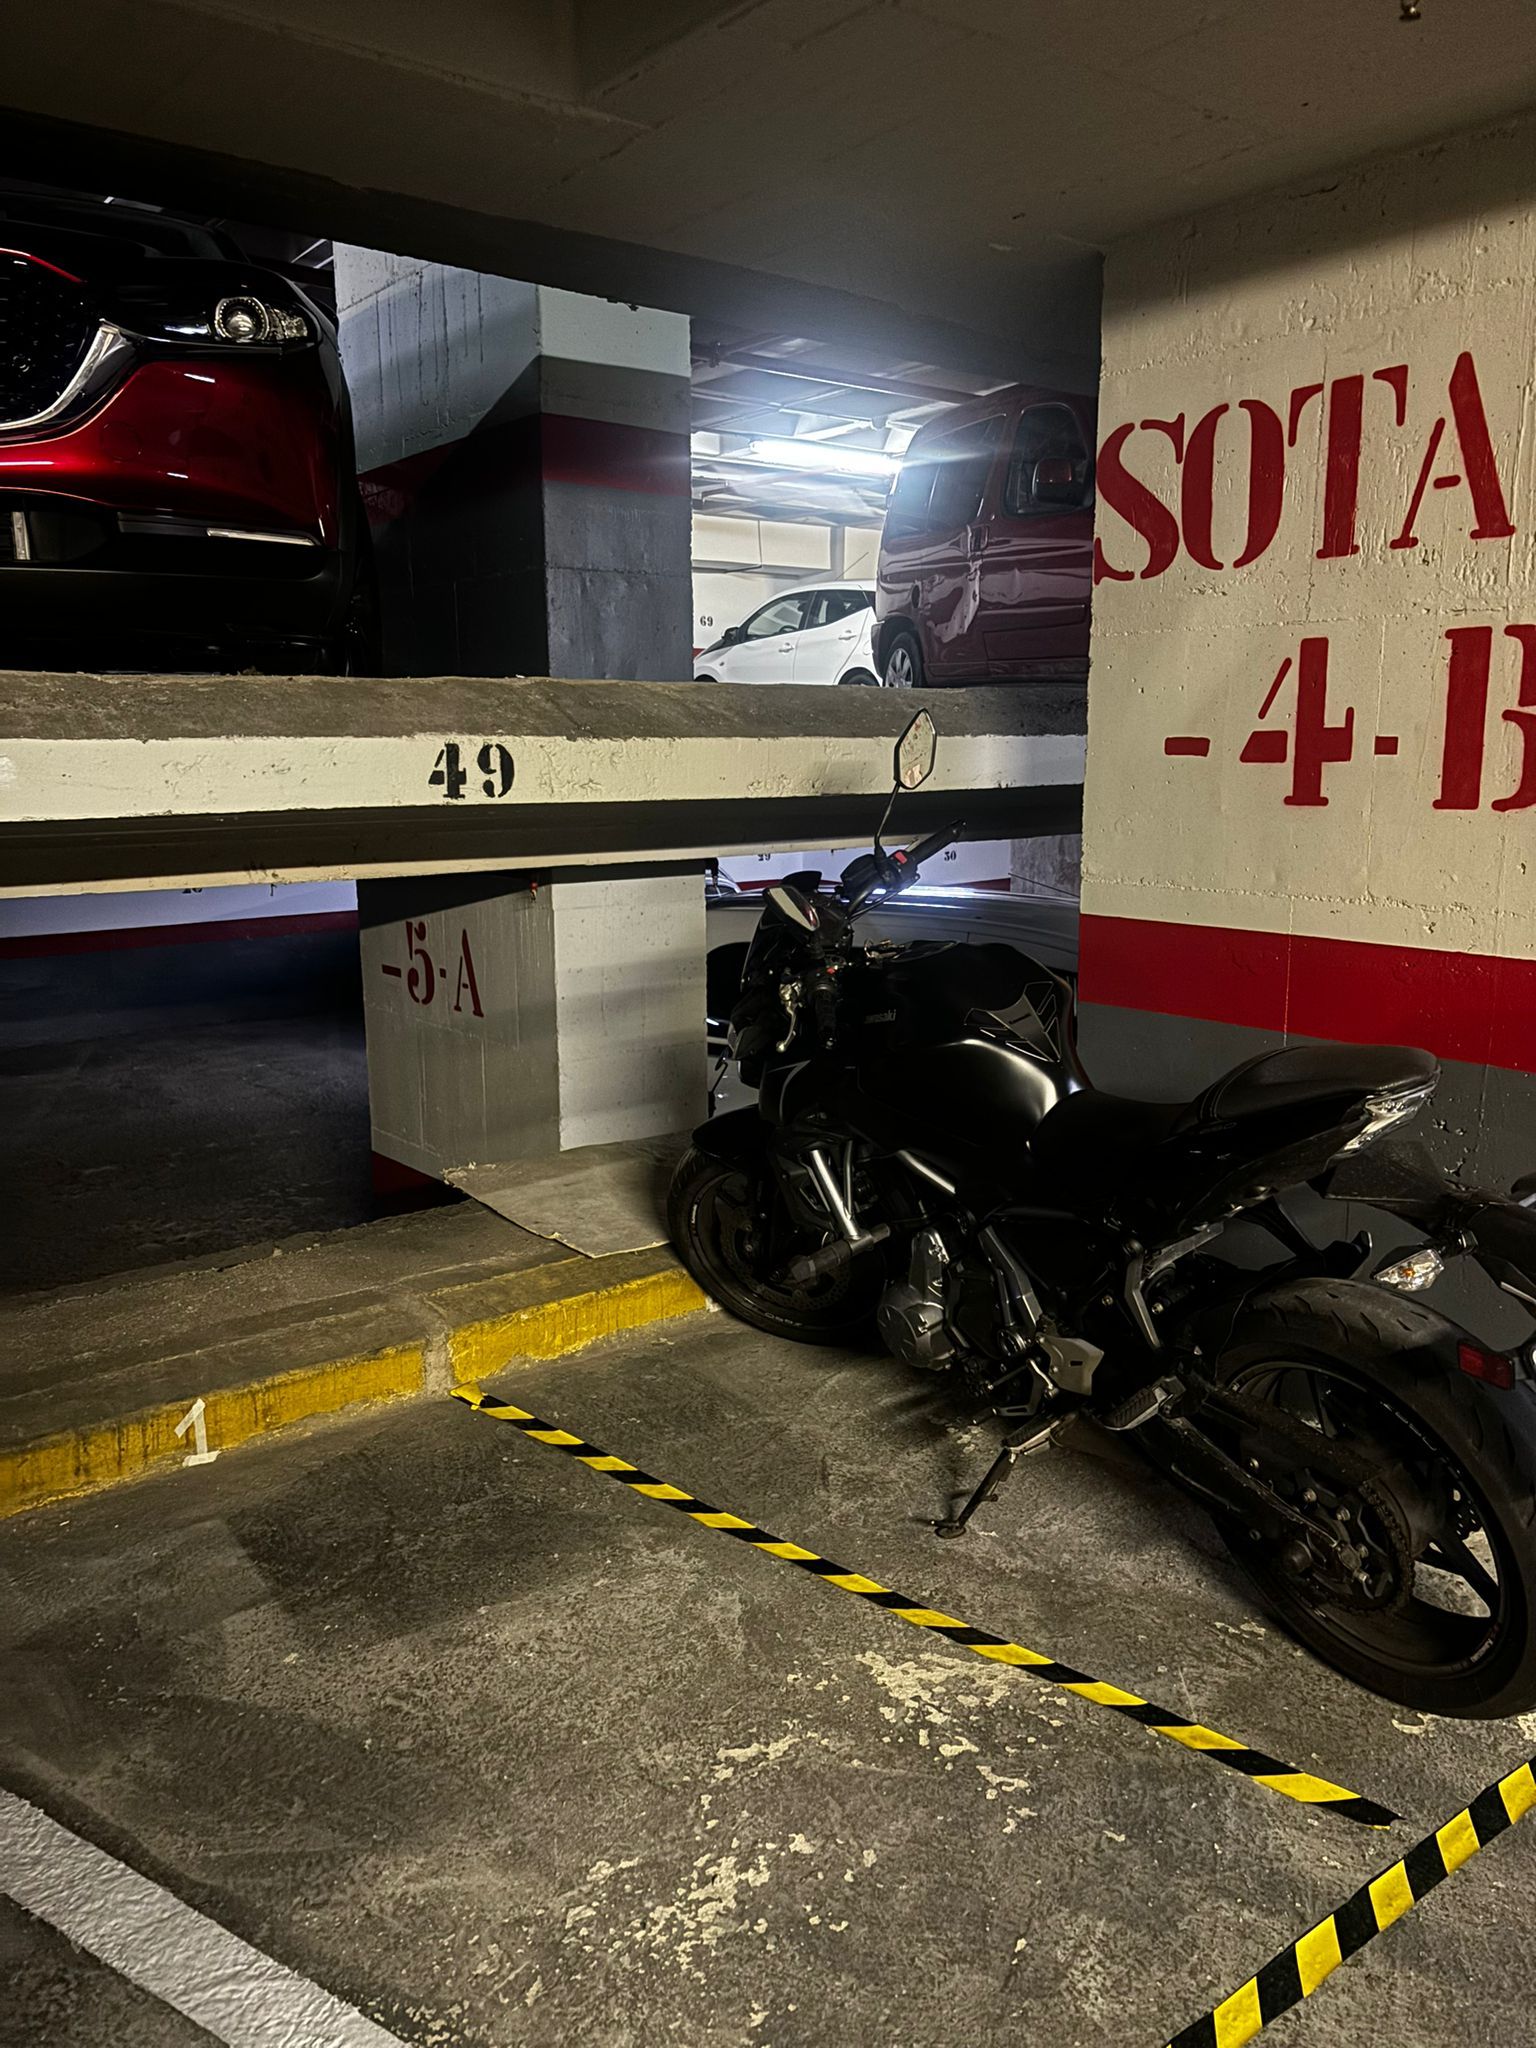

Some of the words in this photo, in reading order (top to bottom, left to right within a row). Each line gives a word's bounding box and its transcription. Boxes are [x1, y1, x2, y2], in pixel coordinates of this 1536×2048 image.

[1094, 351, 1515, 585] SOTA
[699, 615, 714, 627] 69
[427, 742, 516, 800] 49
[174, 1398, 222, 1468] 1
